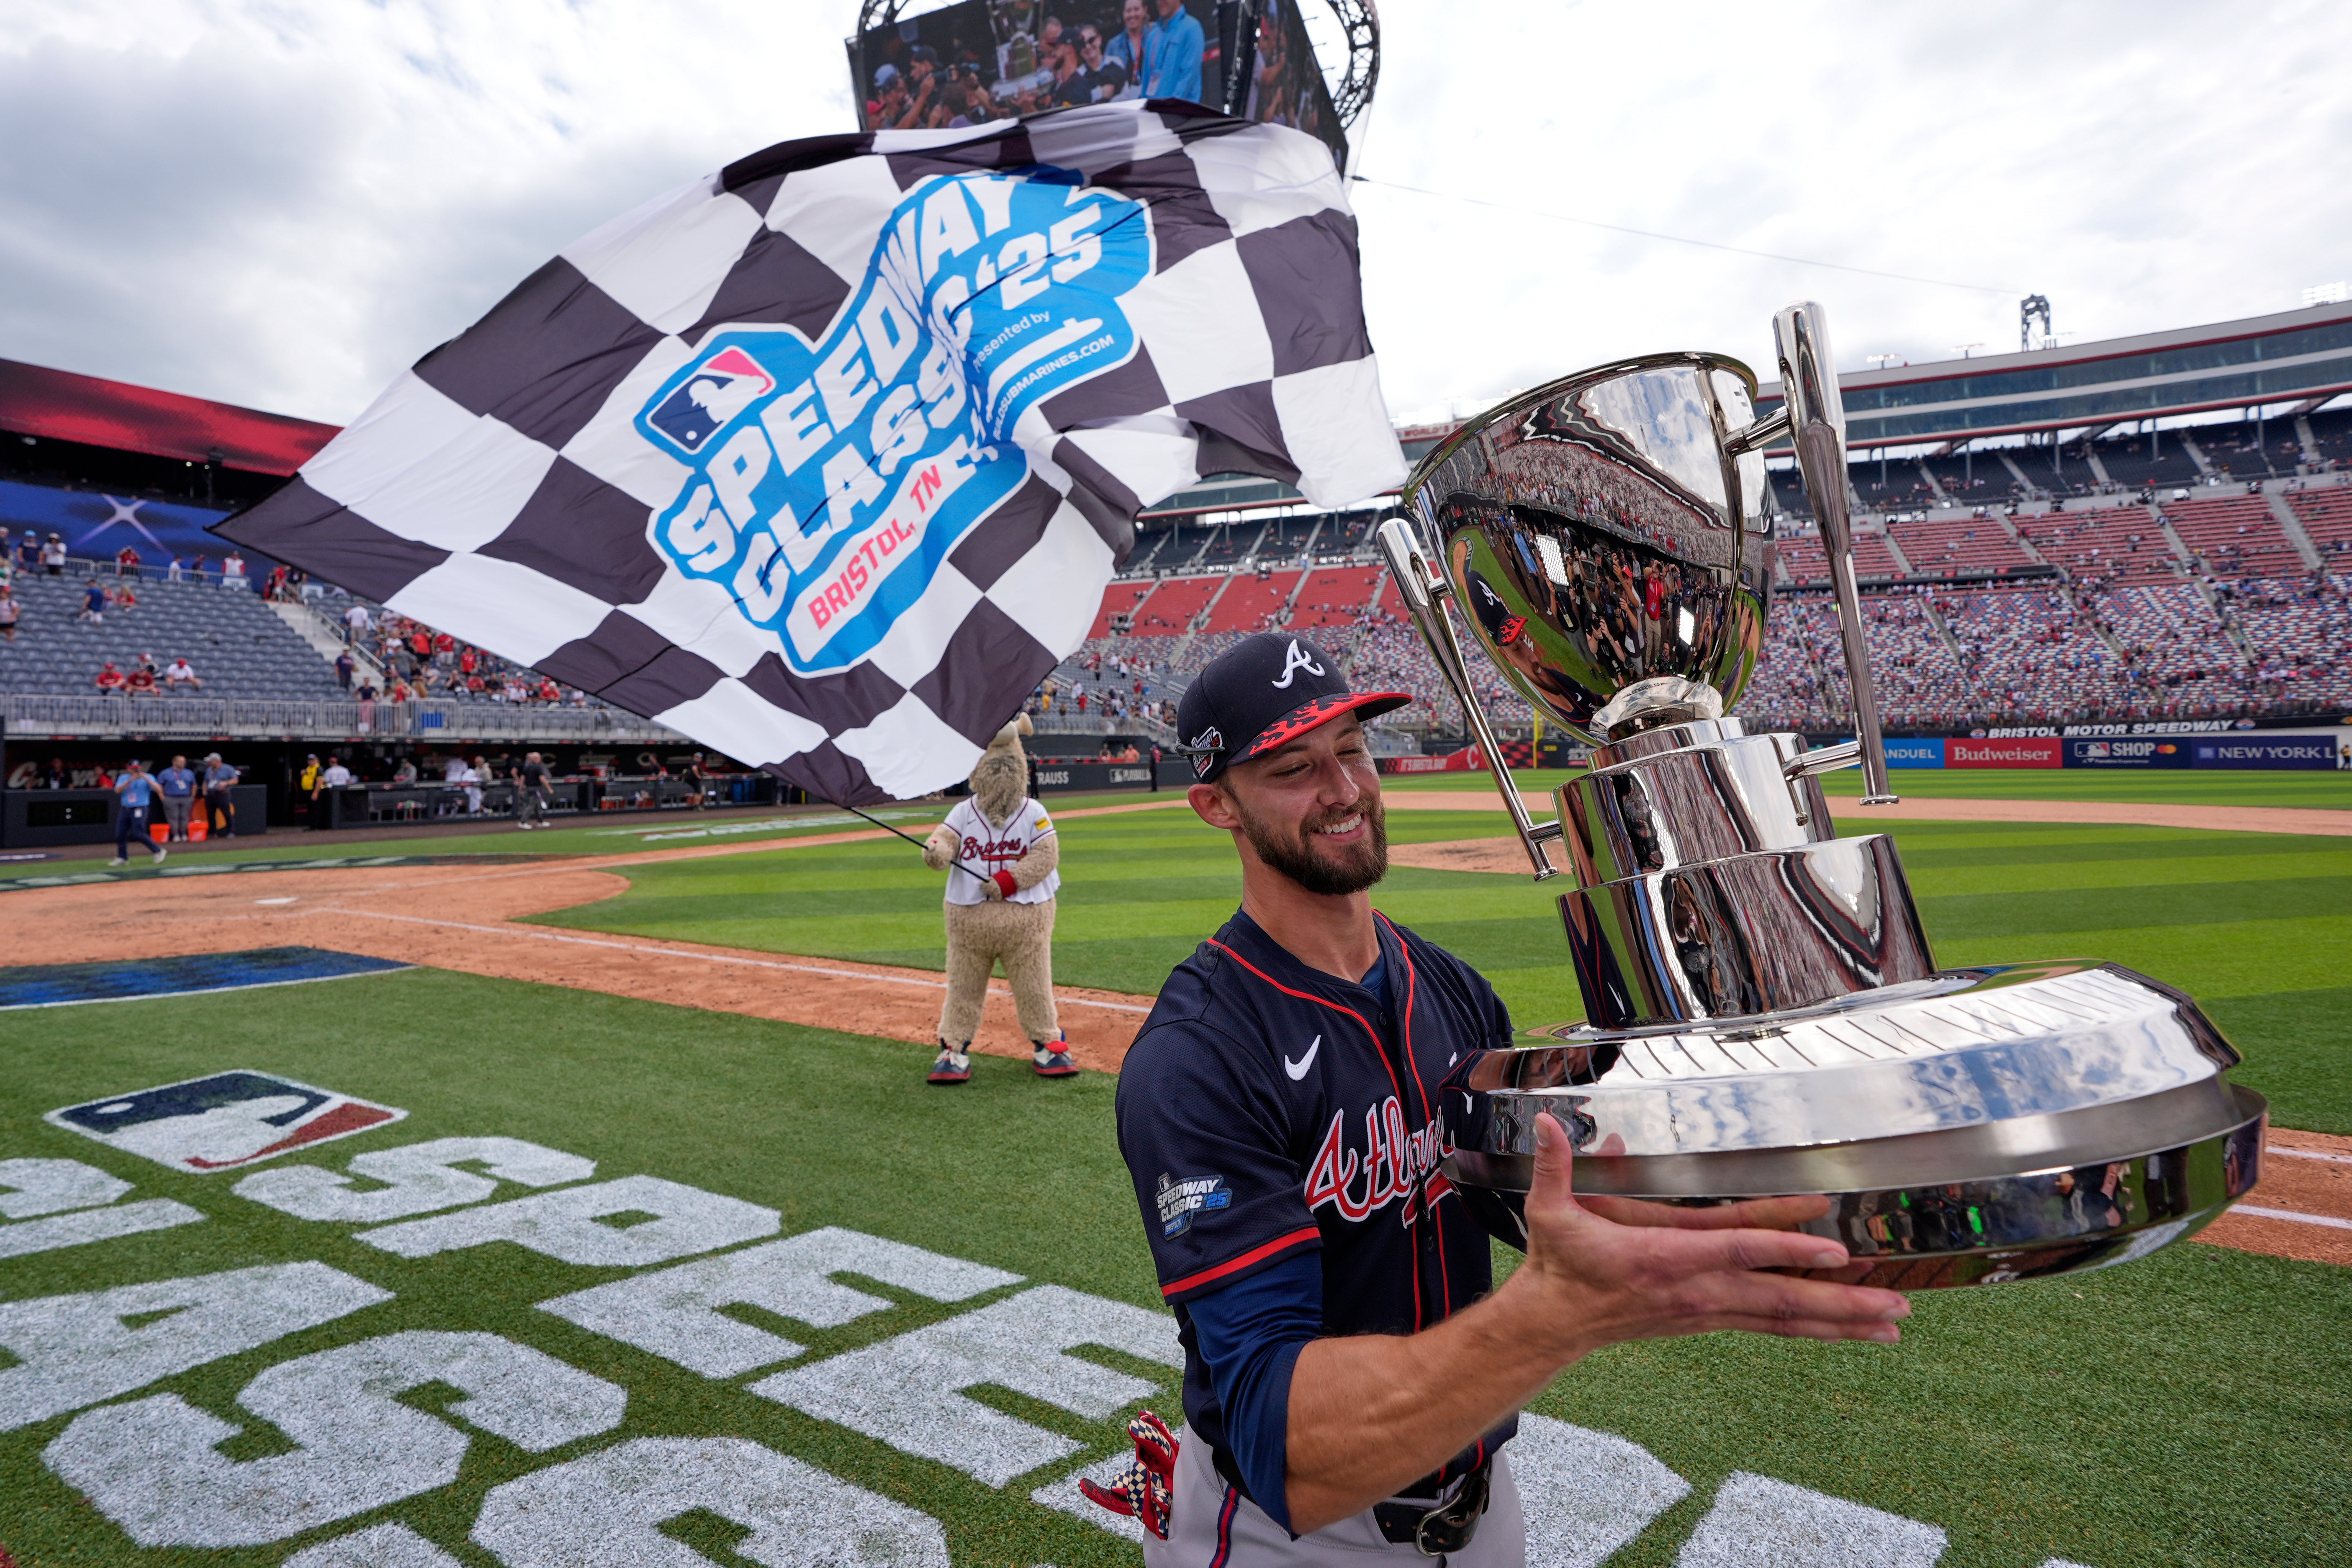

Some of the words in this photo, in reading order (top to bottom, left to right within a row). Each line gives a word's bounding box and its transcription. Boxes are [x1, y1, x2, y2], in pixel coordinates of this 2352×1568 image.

[1030, 311, 1050, 324] by
[910, 464, 942, 514] TN
[1272, 639, 1325, 689] A
[1988, 727, 2059, 739] BRISTOL
[2063, 724, 2128, 736] MOTOR
[2131, 719, 2234, 734] SPEEDWAY
[1883, 749, 1936, 759] ANDUEL
[1953, 746, 2052, 761] Budweiser
[2112, 742, 2156, 756] SHOP
[2218, 747, 2264, 758] NEW
[2265, 746, 2322, 758] YORK
[960, 836, 1021, 860] Braves
[1157, 1179, 1220, 1209] SPEEDWAY
[1161, 1195, 1203, 1223] CLASSIC
[1204, 1193, 1228, 1207] '25
